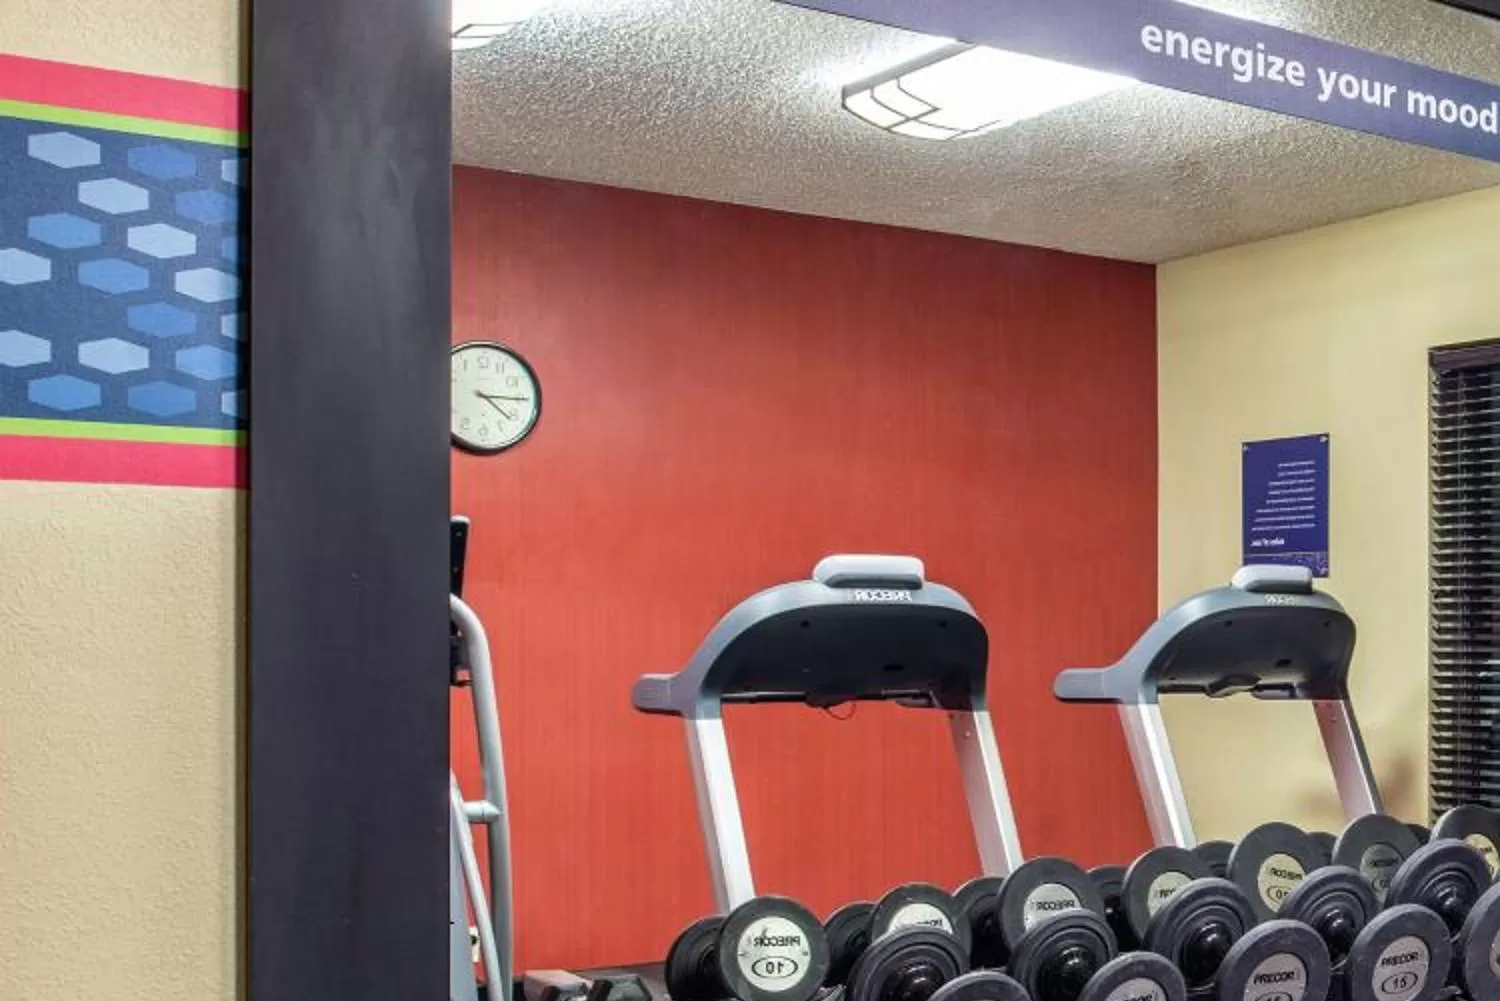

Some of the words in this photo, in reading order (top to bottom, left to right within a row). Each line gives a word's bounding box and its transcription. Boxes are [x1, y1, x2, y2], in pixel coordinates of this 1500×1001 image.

[1141, 25, 1305, 87] energize
[1317, 66, 1396, 108] your
[1381, 951, 1419, 968] PRECOR
[1253, 971, 1295, 985] PRECOR
[1394, 976, 1407, 989] 15
